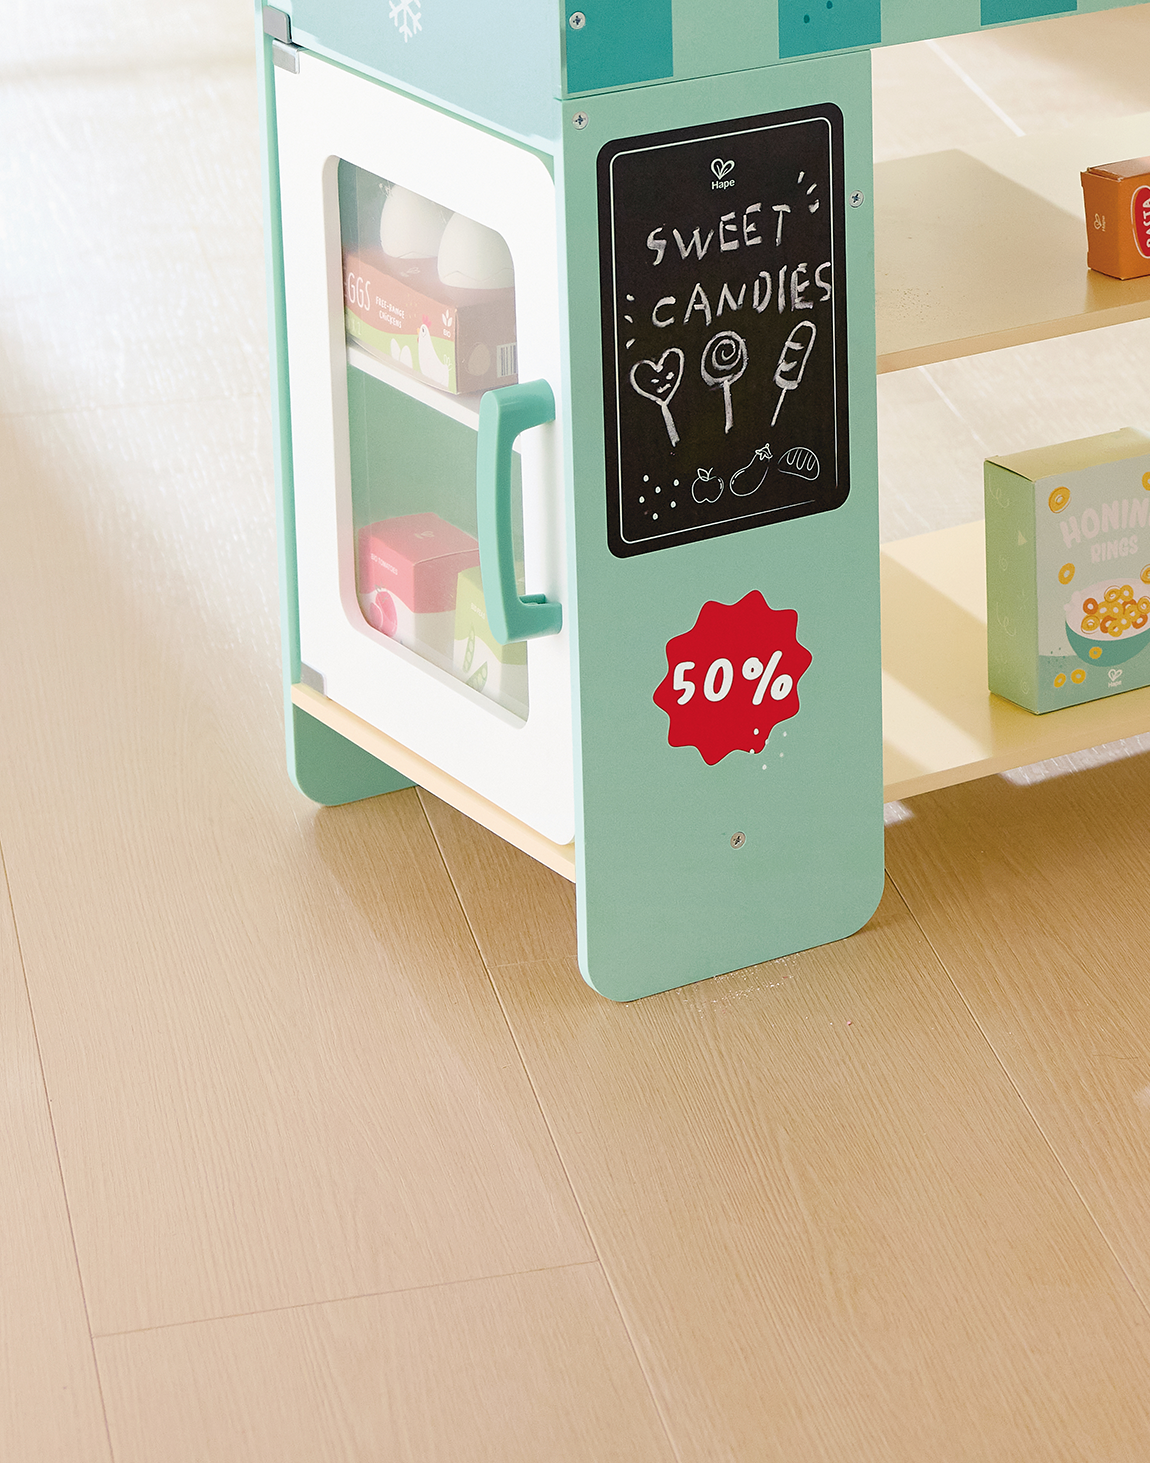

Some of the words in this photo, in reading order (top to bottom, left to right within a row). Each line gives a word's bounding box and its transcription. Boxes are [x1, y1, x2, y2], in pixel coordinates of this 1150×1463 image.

[711, 179, 736, 190] Hape
[646, 202, 792, 266] SWEET
[375, 296, 405, 319] FREE-RANGE
[652, 261, 832, 328] CANDIES
[443, 328, 452, 338] BIO
[1091, 535, 1139, 564] RINGS
[672, 650, 794, 706] 50%
